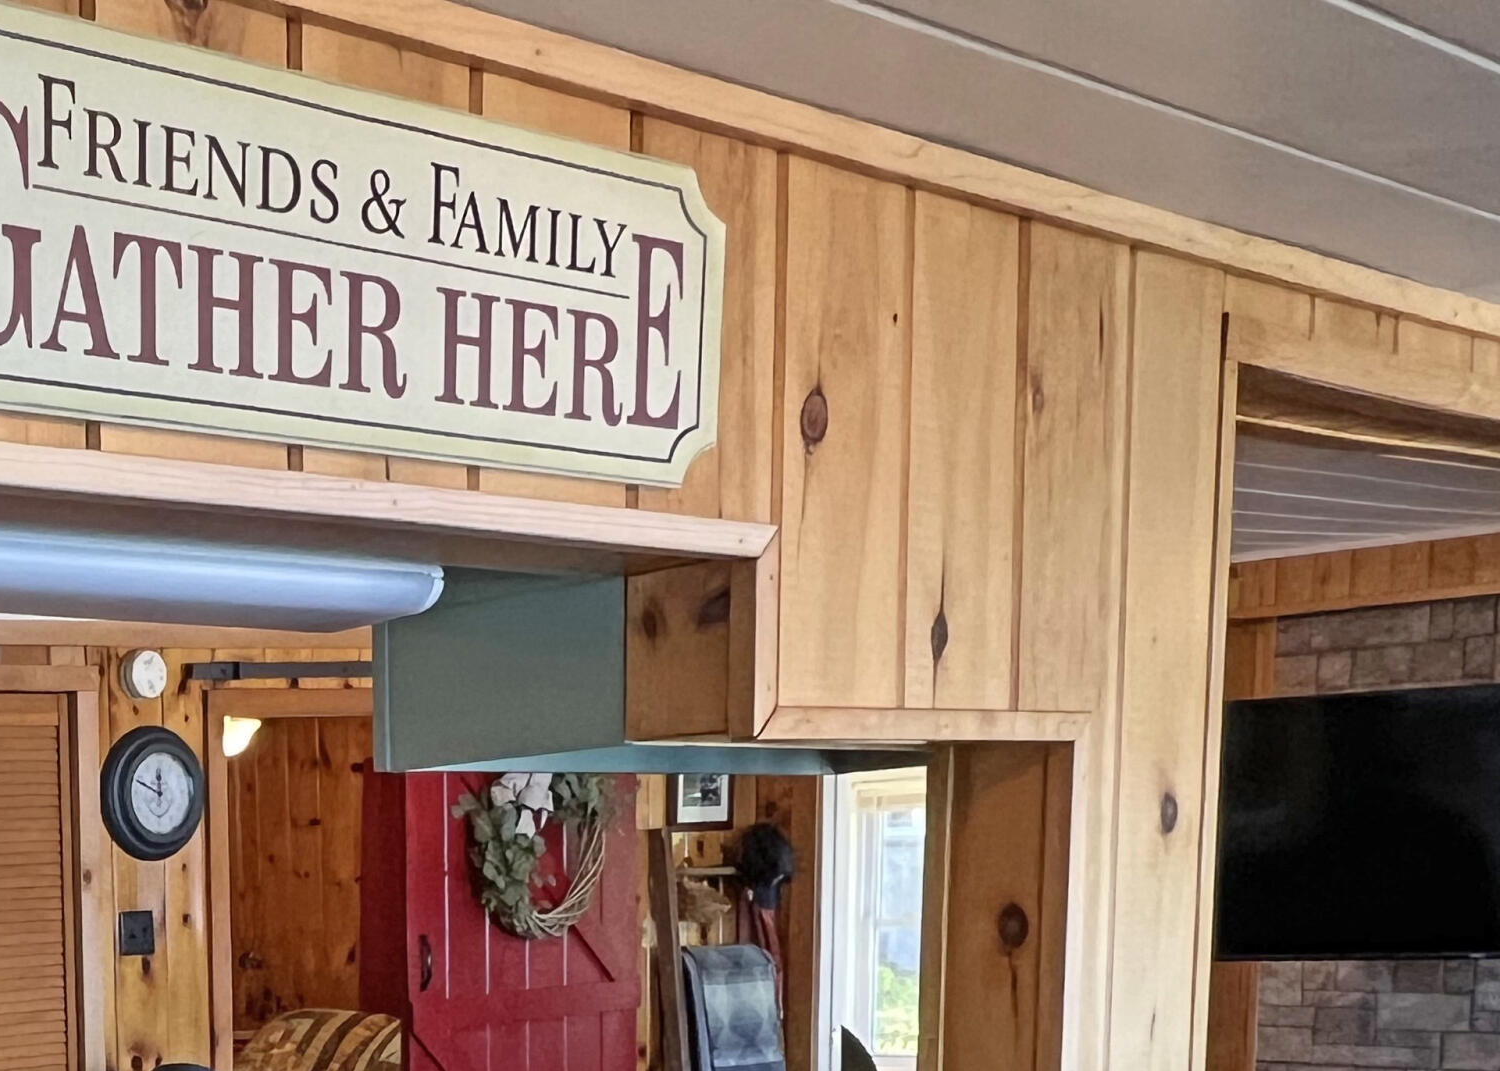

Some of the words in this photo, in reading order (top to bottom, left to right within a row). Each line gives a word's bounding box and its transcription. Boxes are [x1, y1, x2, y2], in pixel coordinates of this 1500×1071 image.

[37, 73, 339, 225] FRIENDS
[360, 169, 407, 237] &
[427, 161, 629, 279] FAMILY
[434, 232, 686, 430] HERE
